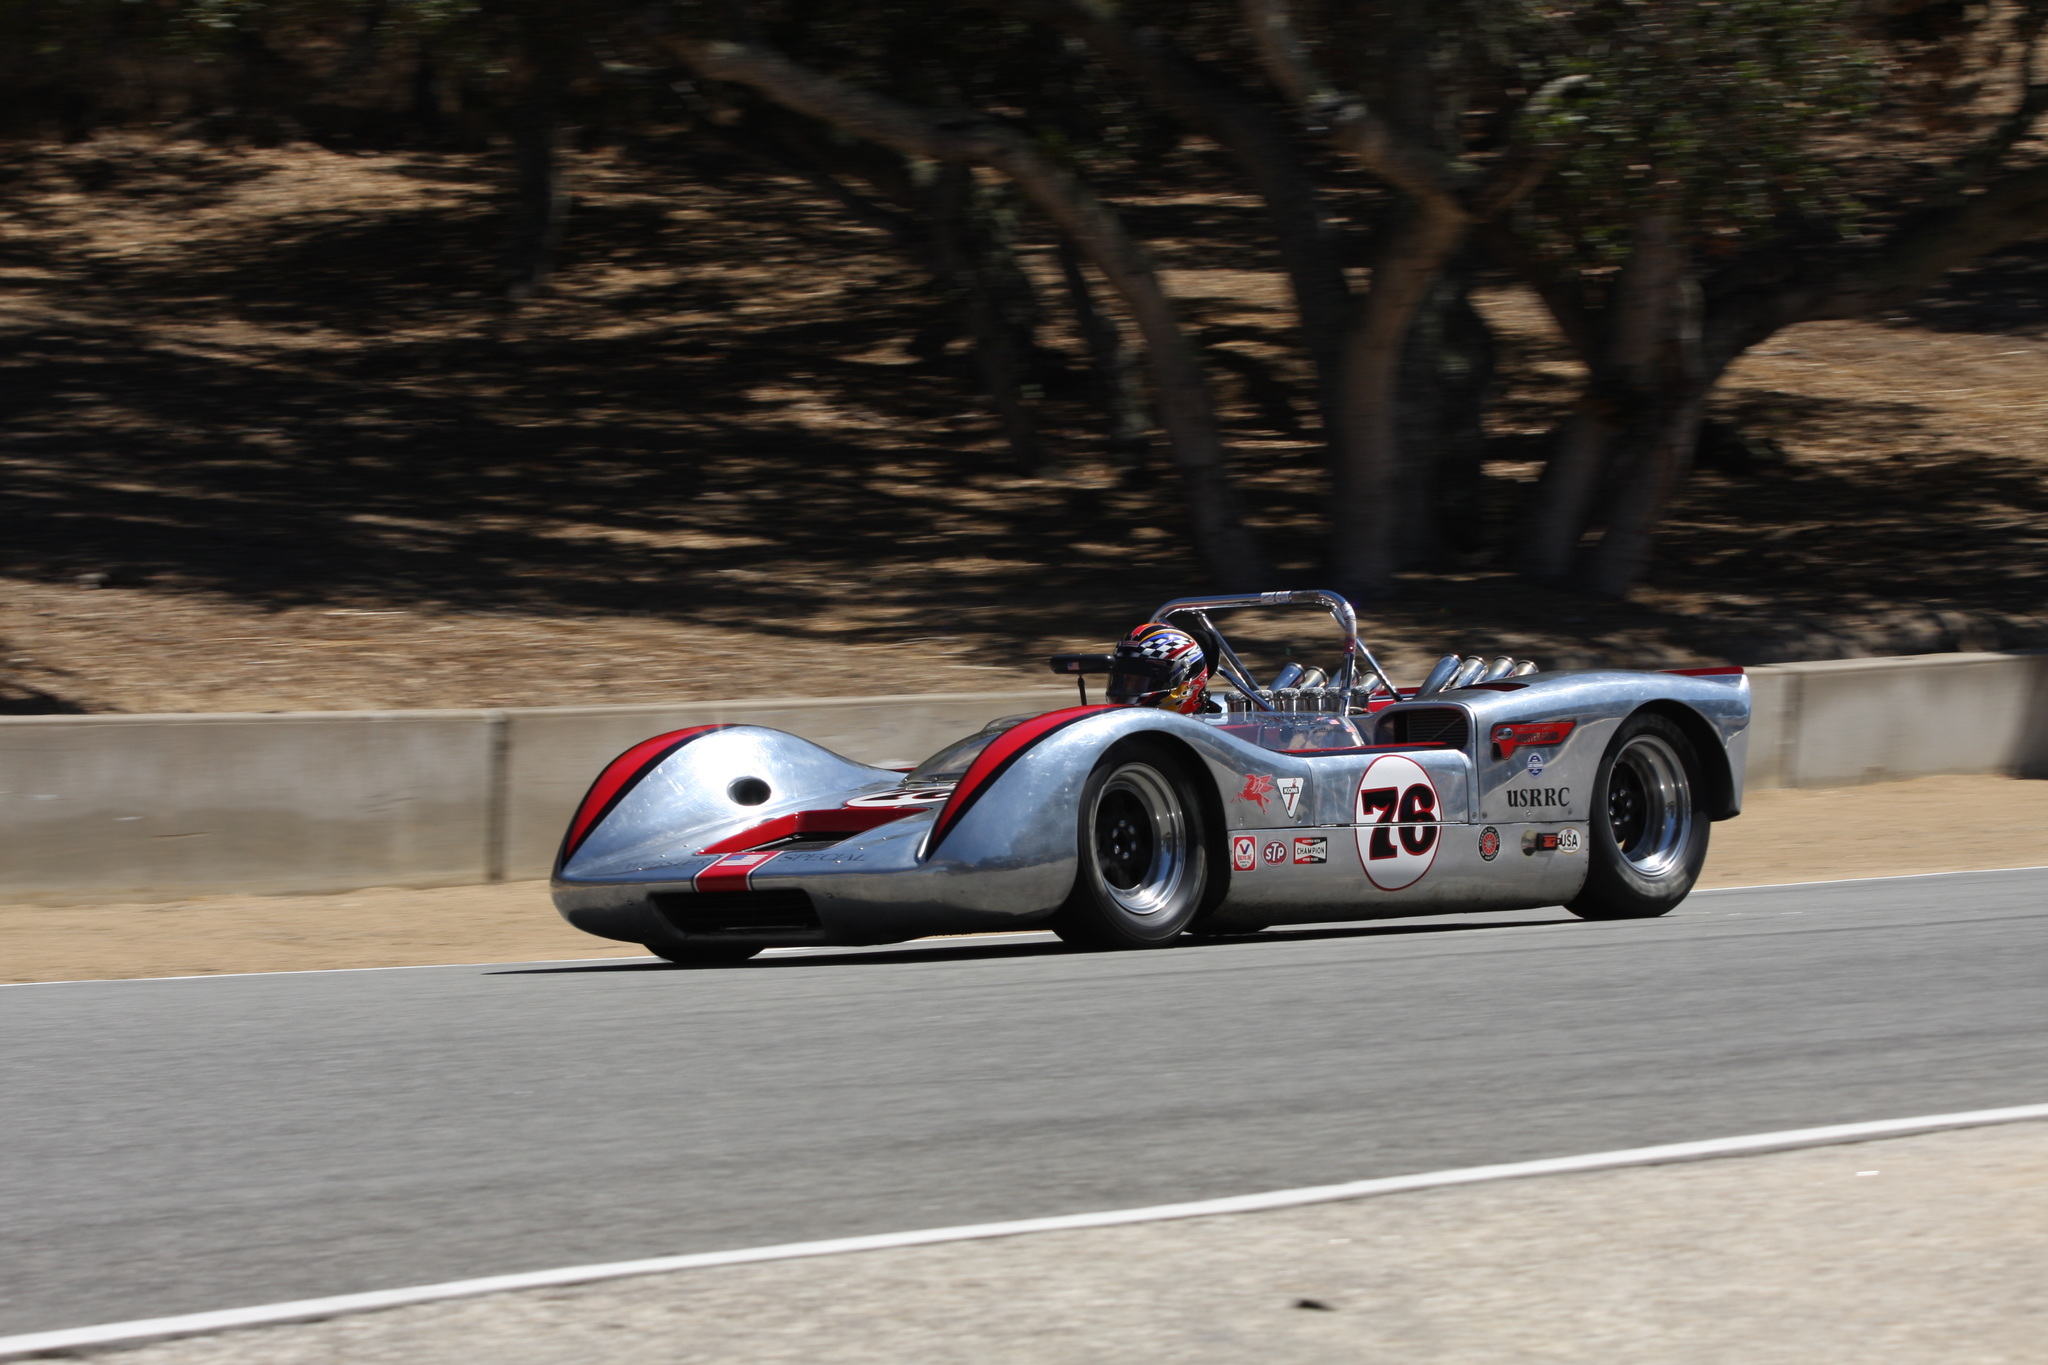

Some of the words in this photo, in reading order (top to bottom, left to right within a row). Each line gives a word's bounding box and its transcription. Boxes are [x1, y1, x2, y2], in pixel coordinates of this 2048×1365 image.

[1361, 783, 1438, 860] 76
[1561, 834, 1578, 847] USA
[777, 853, 866, 862] SPECIAL
[1265, 843, 1284, 861] STP
[1296, 847, 1325, 855] CHAMPION
